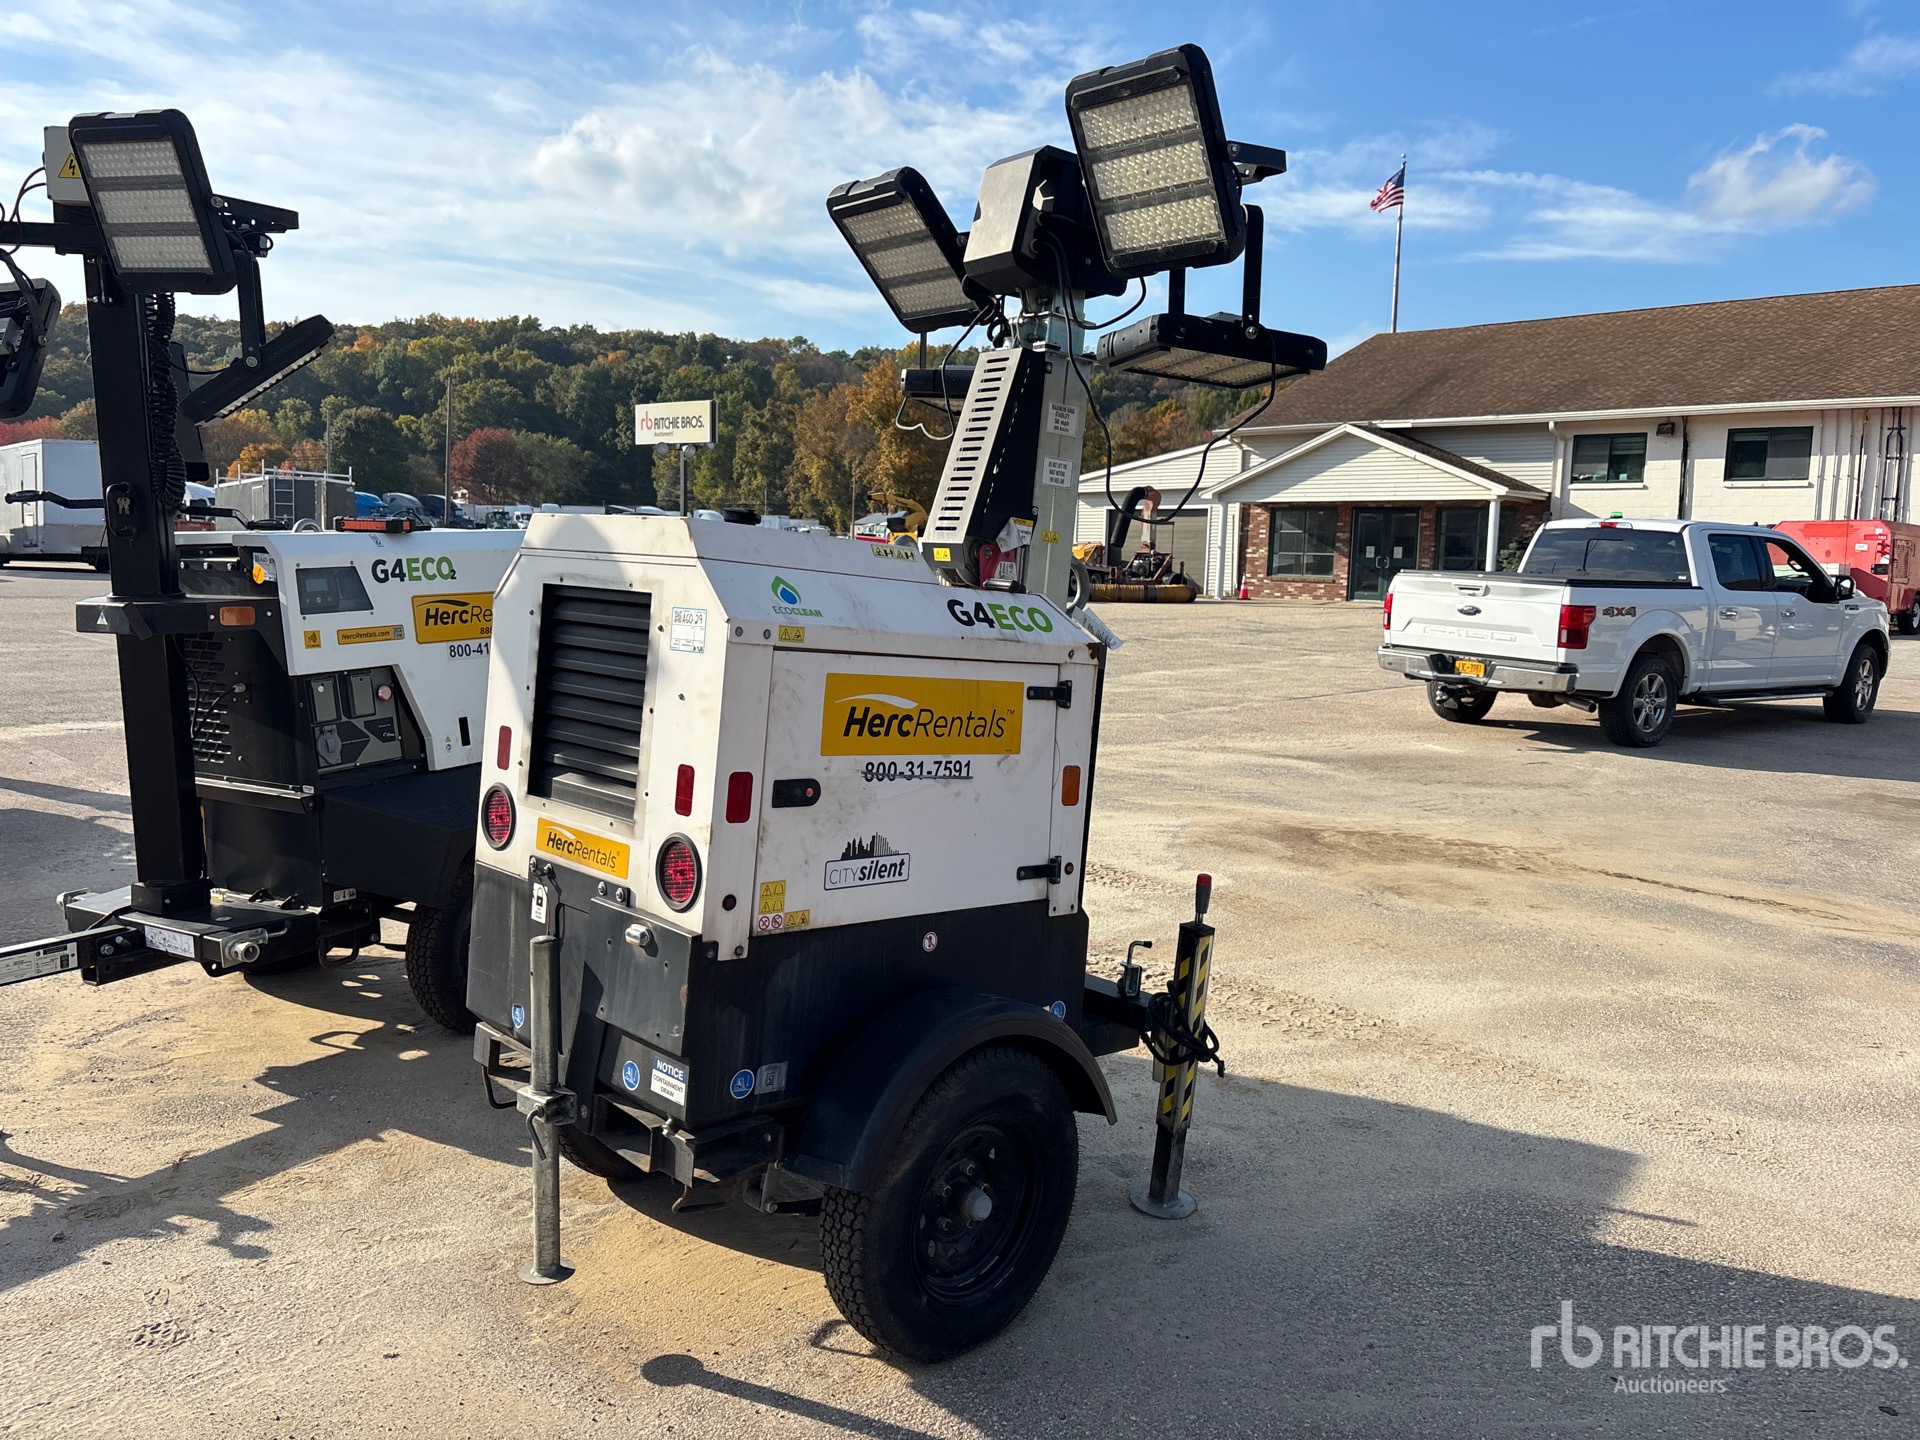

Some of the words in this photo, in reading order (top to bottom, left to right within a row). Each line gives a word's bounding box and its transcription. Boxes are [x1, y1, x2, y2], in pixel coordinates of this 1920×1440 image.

[654, 417, 680, 430] RITCHIE
[681, 415, 704, 429] BROS.
[772, 605, 824, 617] ECOCLEAN
[947, 599, 1054, 633] G4ECO
[342, 631, 391, 640] HercRentals.com
[1424, 626, 1517, 643] F-150
[864, 760, 972, 783] 800-31-7591
[546, 831, 617, 869] HercRentals
[656, 1059, 684, 1081] NOTICE
[653, 1073, 684, 1094] CONTAINMENT
[660, 1086, 675, 1098] DRAIN
